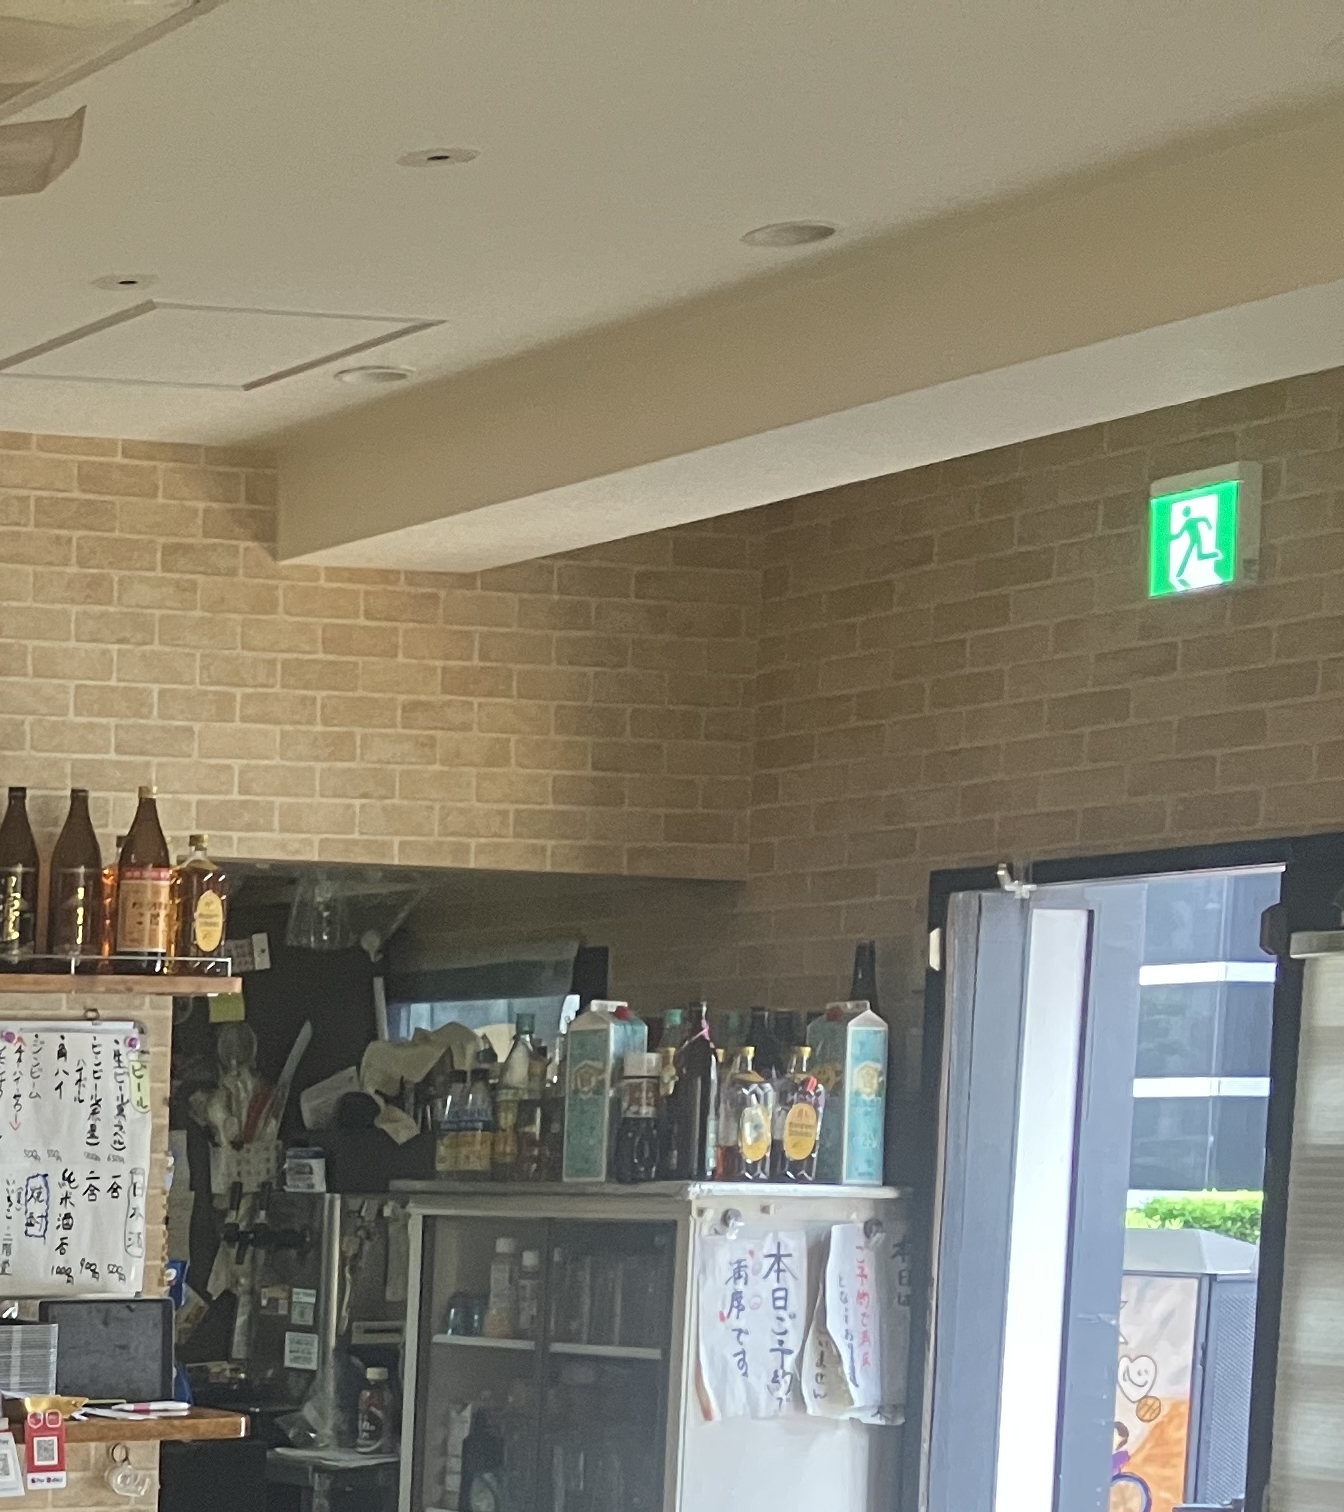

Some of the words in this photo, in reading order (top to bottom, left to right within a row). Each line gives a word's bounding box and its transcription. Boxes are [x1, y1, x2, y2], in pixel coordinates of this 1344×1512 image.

[54, 1043, 70, 1100] 角ハイ
[131, 1062, 149, 1110] ビール
[724, 1258, 750, 1378] 満席です
